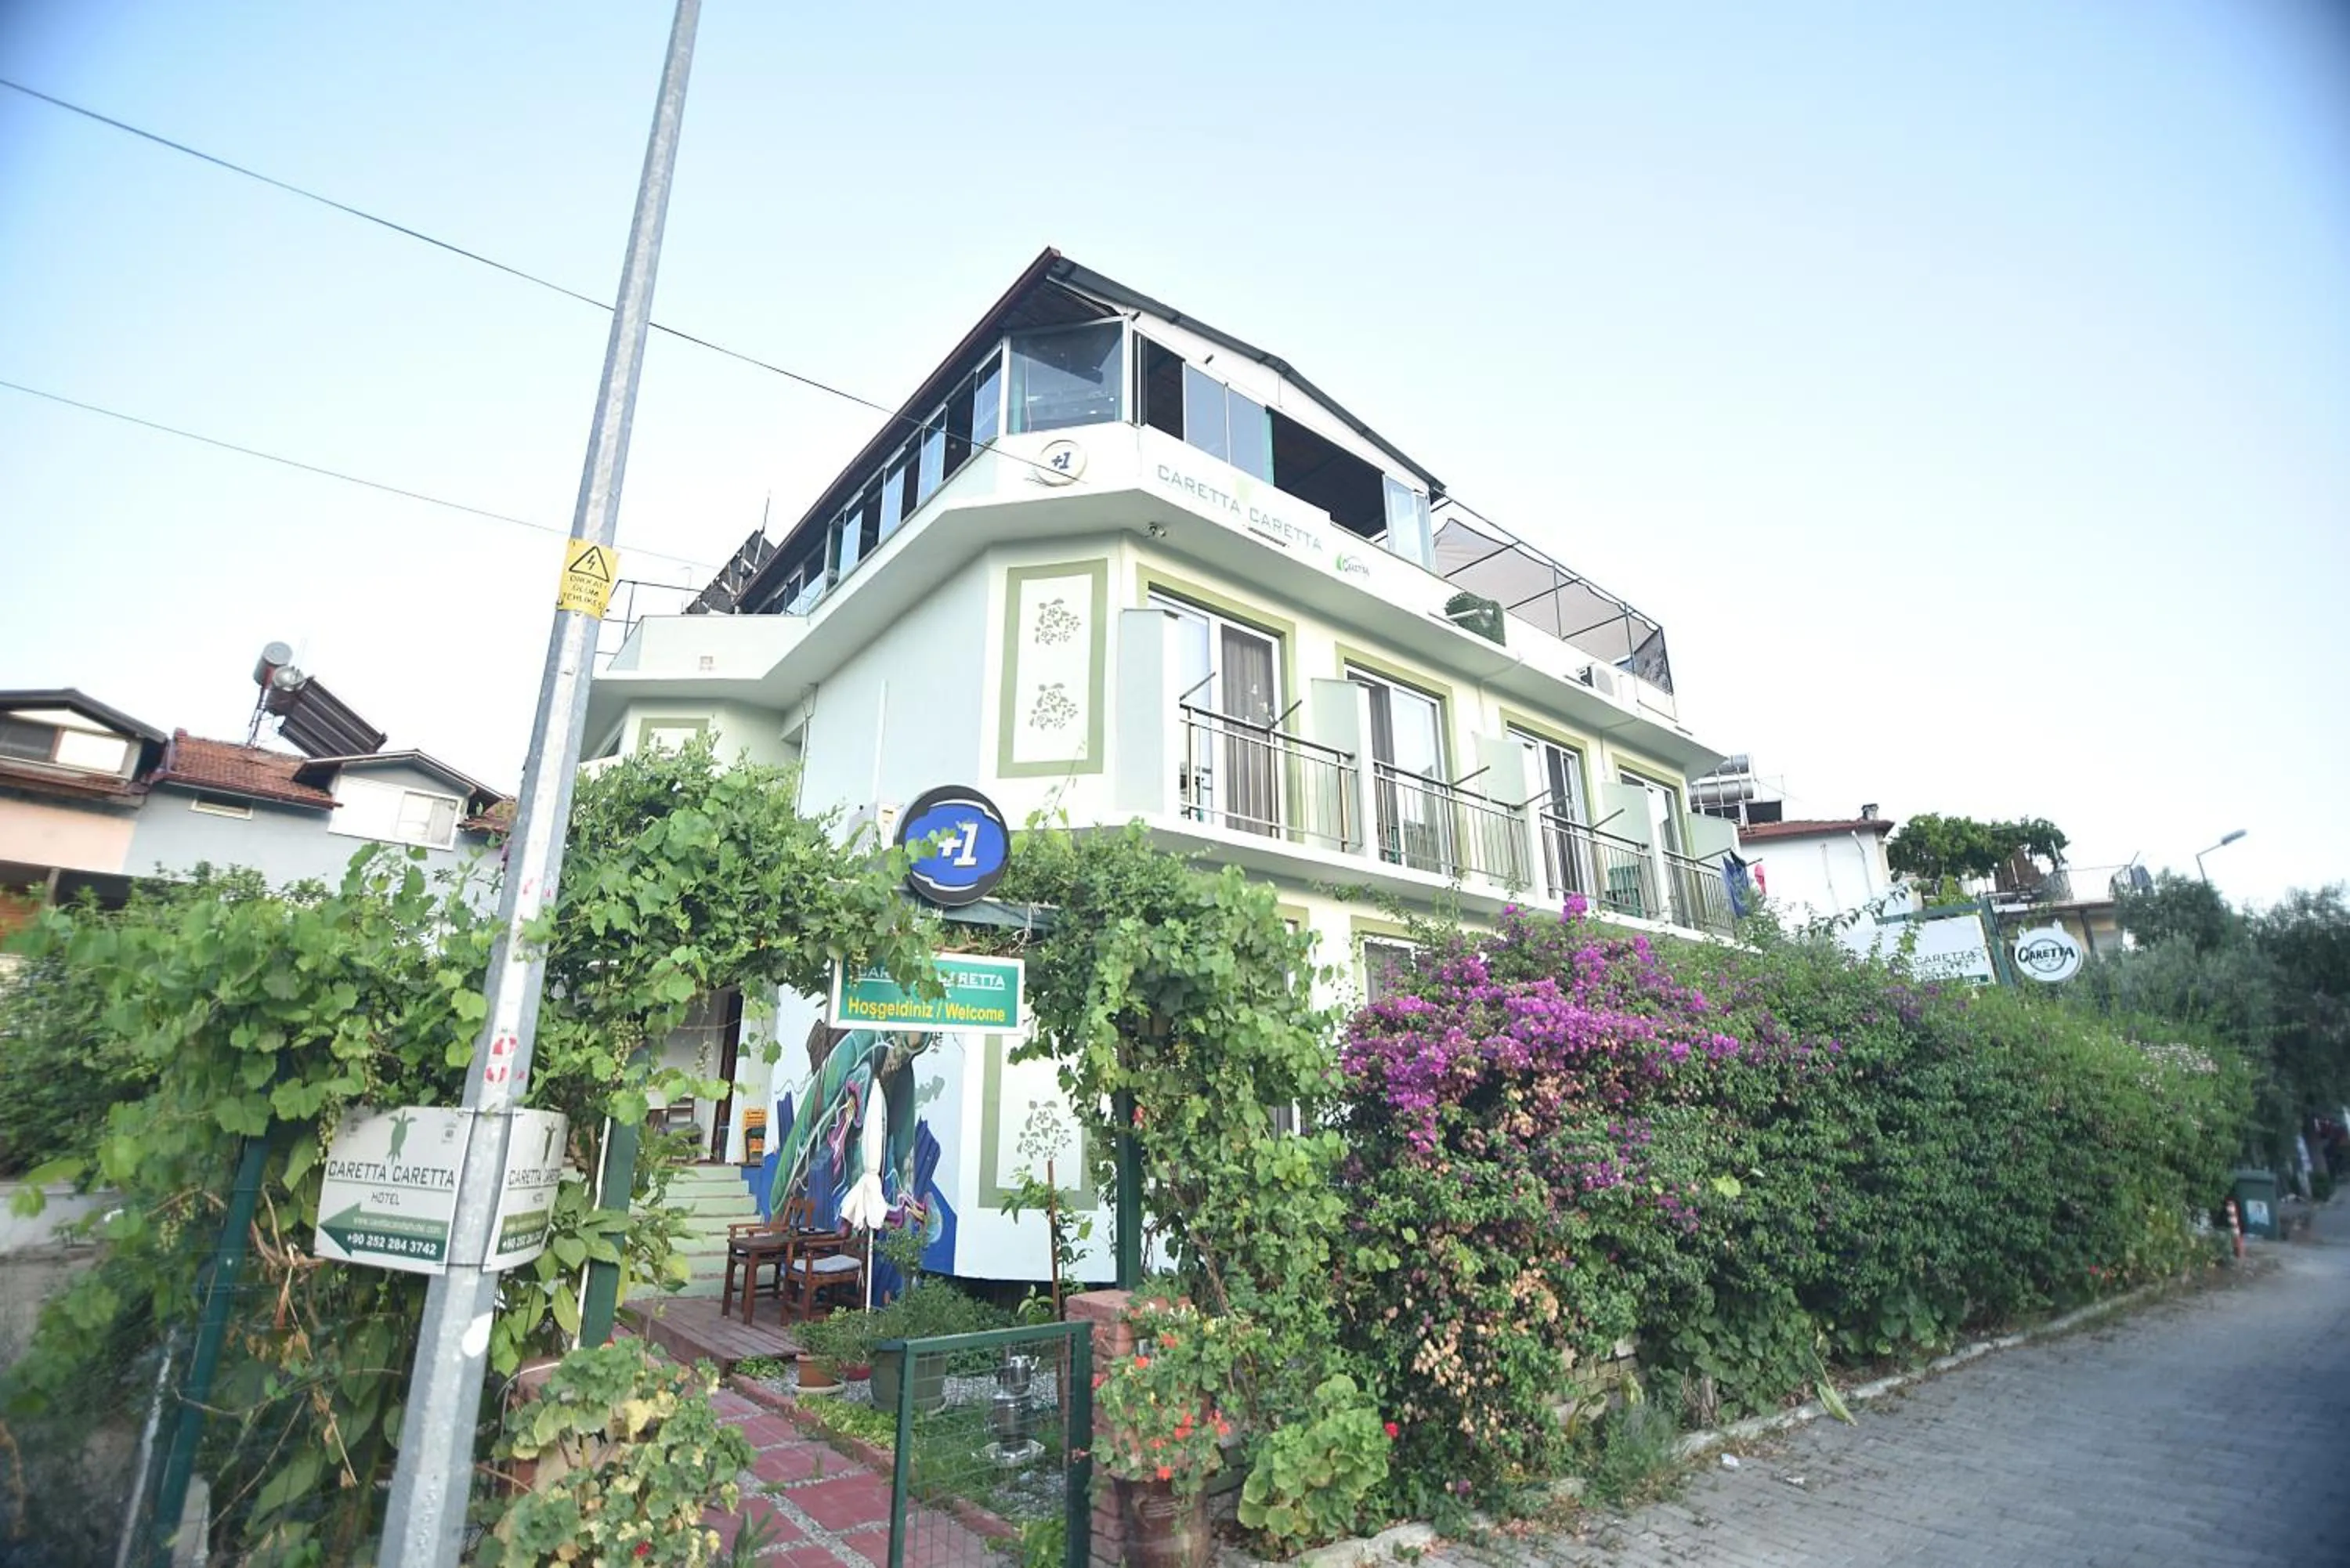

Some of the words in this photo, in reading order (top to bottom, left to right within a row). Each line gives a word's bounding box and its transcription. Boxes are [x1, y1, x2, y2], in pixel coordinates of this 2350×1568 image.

[1050, 451, 1071, 470] +1
[1157, 463, 1242, 515] CARETTA
[1249, 507, 1324, 552] CARETTA
[937, 822, 978, 866] +1
[1914, 950, 1976, 966] CARETTA
[2018, 946, 2075, 963] CARETTA
[848, 996, 934, 1020] Hoşgeldiniz
[936, 1002, 942, 1020] /
[945, 1002, 1007, 1022] Welcome
[328, 1160, 387, 1183] CARETTA
[393, 1165, 455, 1187] CARETTA
[371, 1191, 401, 1205] HOTEL
[366, 1234, 386, 1248] 252
[408, 1241, 438, 1256] 3742
